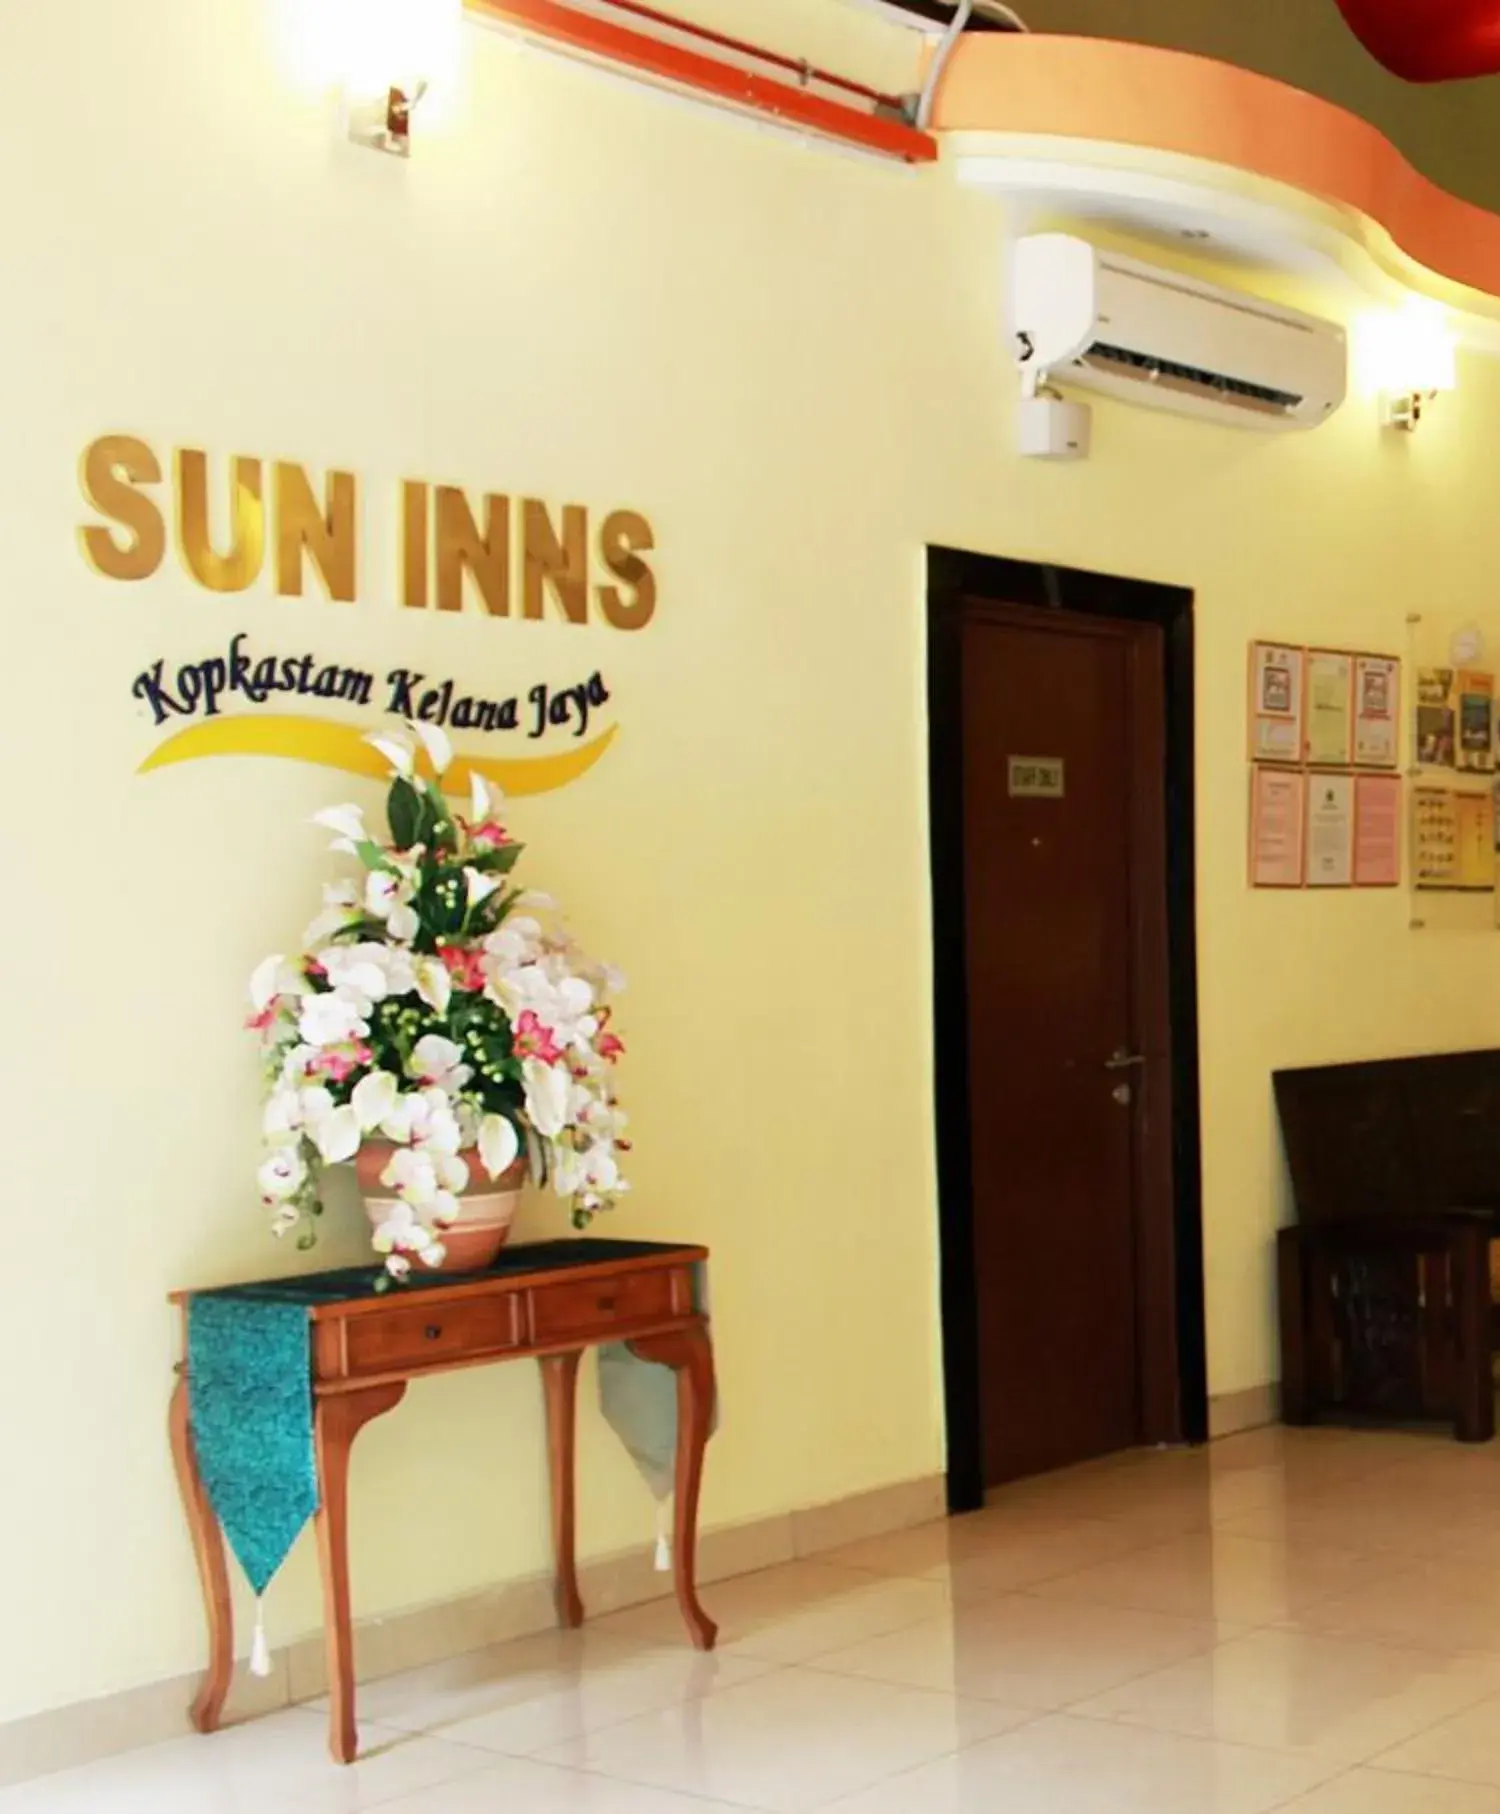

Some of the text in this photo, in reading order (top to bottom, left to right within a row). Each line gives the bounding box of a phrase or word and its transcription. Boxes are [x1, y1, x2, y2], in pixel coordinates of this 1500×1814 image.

[77, 434, 657, 632] SUN INNS
[132, 633, 609, 738] Kopkastam Kelana Jaya
